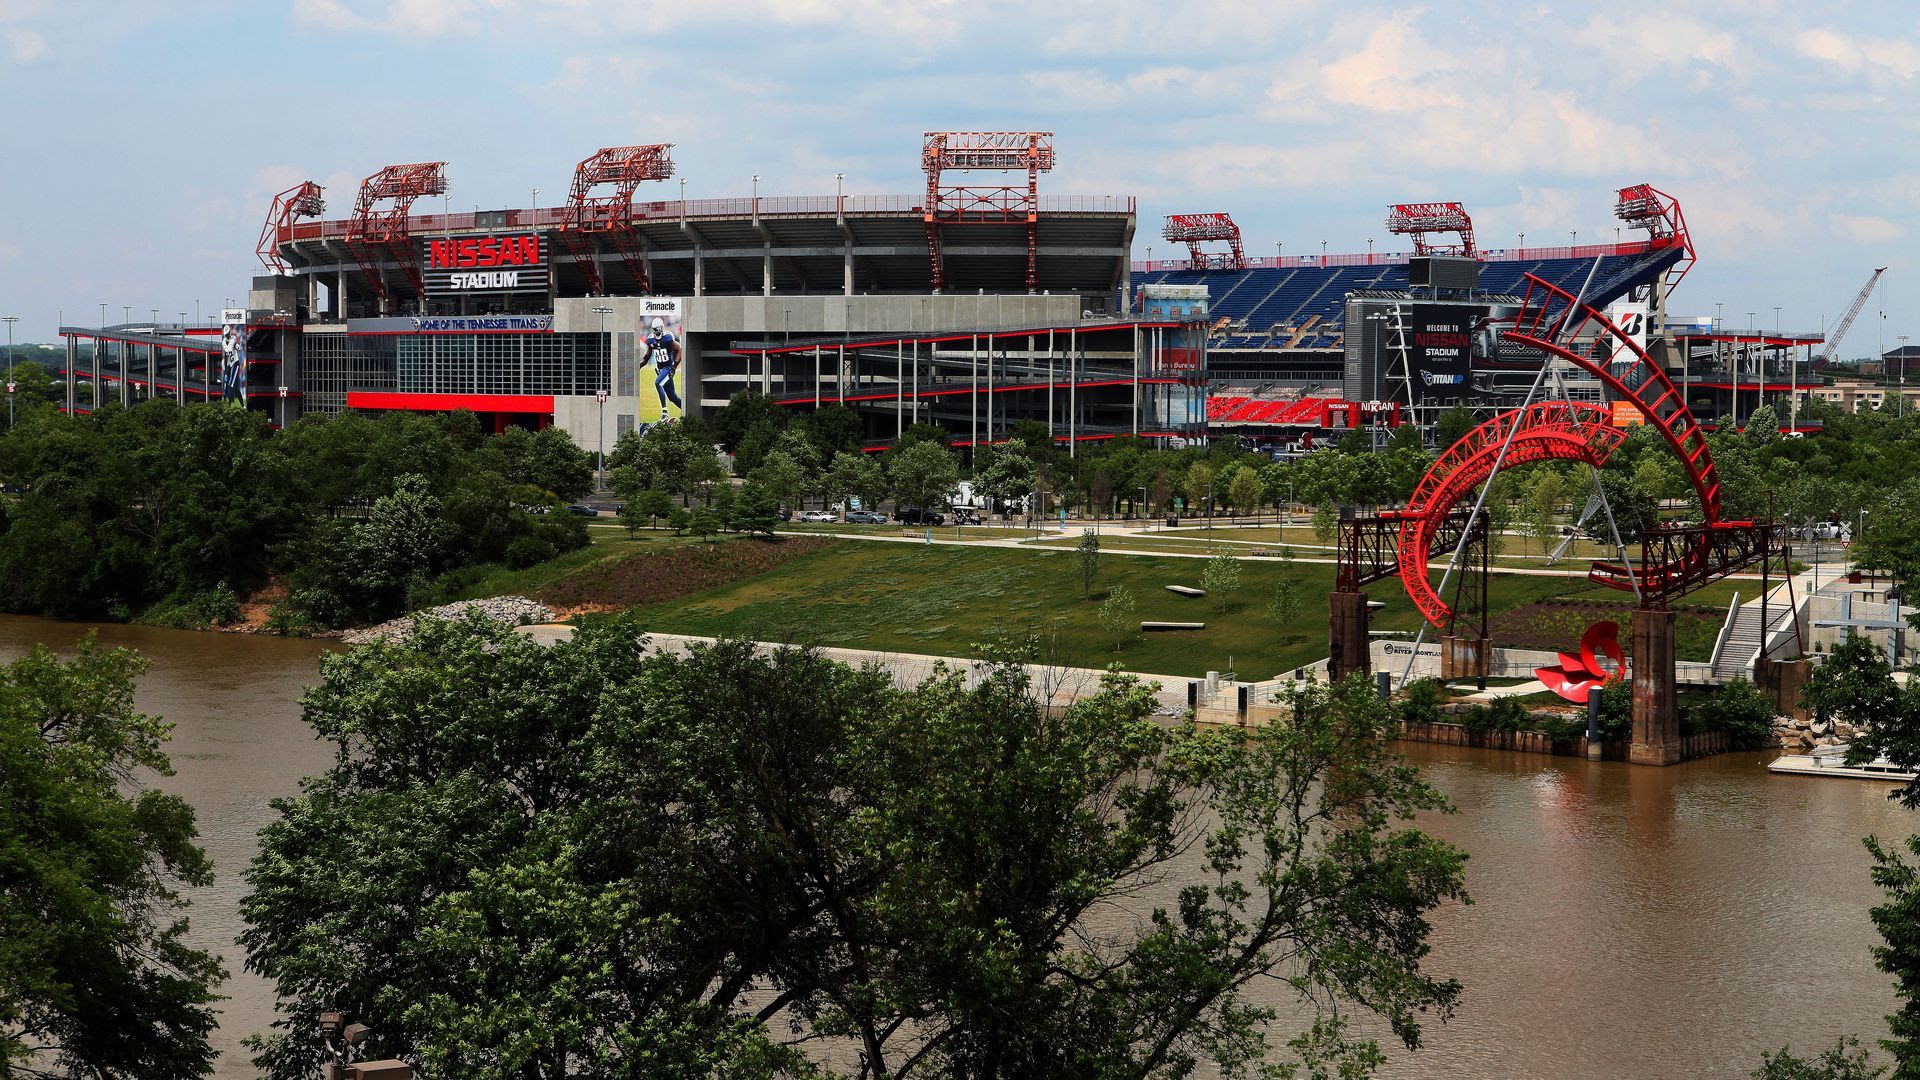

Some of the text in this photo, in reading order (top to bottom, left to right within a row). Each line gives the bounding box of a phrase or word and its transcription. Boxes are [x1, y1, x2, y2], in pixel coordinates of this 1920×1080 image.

[430, 236, 539, 268] NISSAN
[450, 271, 518, 289] STADIUM
[645, 301, 675, 311] Pinnacle
[420, 318, 538, 330] HOME OF THE TENNESSEE TITANS
[1426, 324, 1459, 332] WELCOME TO
[1415, 332, 1469, 347] NISSAN
[1425, 348, 1459, 356] STADIUM
[598, 394, 605, 402] H
[1371, 404, 1378, 412] K
